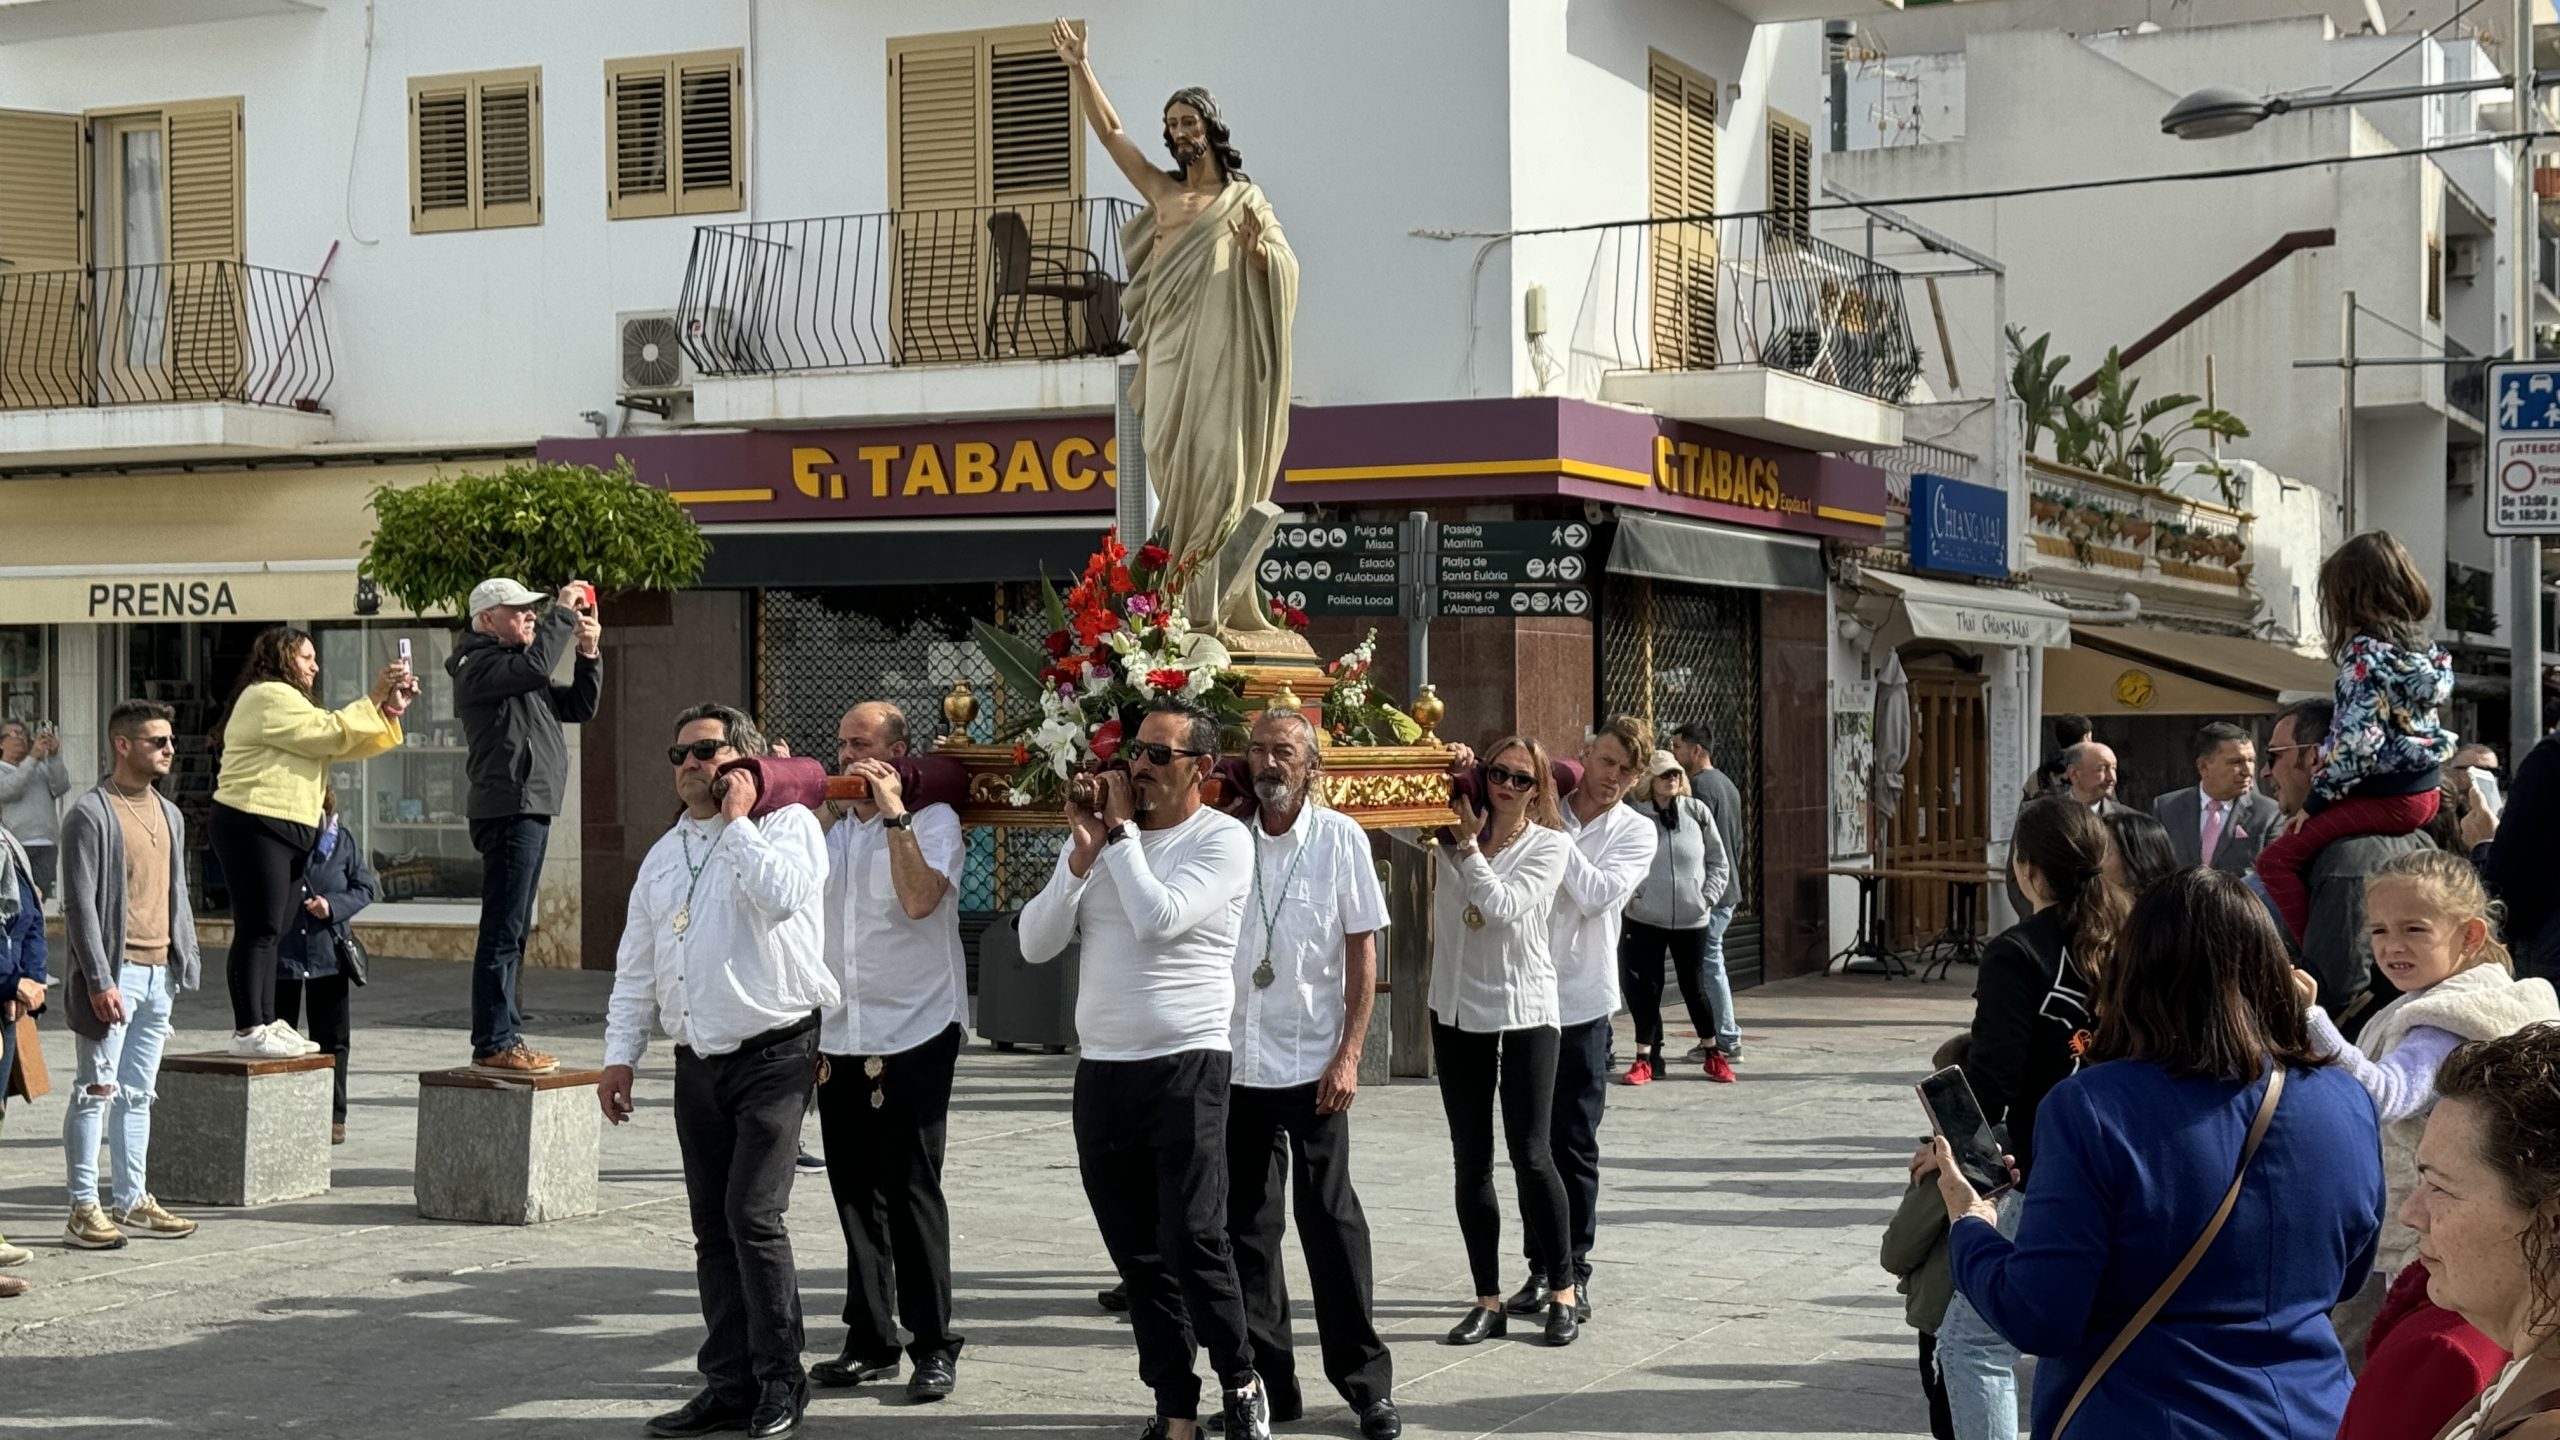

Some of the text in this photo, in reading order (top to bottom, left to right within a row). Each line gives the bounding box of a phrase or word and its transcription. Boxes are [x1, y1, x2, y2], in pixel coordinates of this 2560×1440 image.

[1679, 441, 1780, 509] TABACS
[2502, 495, 2515, 506] De
[2501, 509, 2515, 520] De
[1354, 525, 1394, 538] Puig de
[1443, 524, 1483, 537] Passeig
[1365, 539, 1394, 549] Missa
[1359, 557, 1396, 569] Estació
[1442, 556, 1488, 568] Platja de
[1335, 572, 1395, 583] d'Autobusos
[1442, 570, 1472, 581] Santa
[88, 581, 238, 617] PRENSA
[1364, 594, 1394, 605] Local
[1442, 589, 1500, 602] Passeig de
[1443, 603, 1495, 614] s'Alamera
